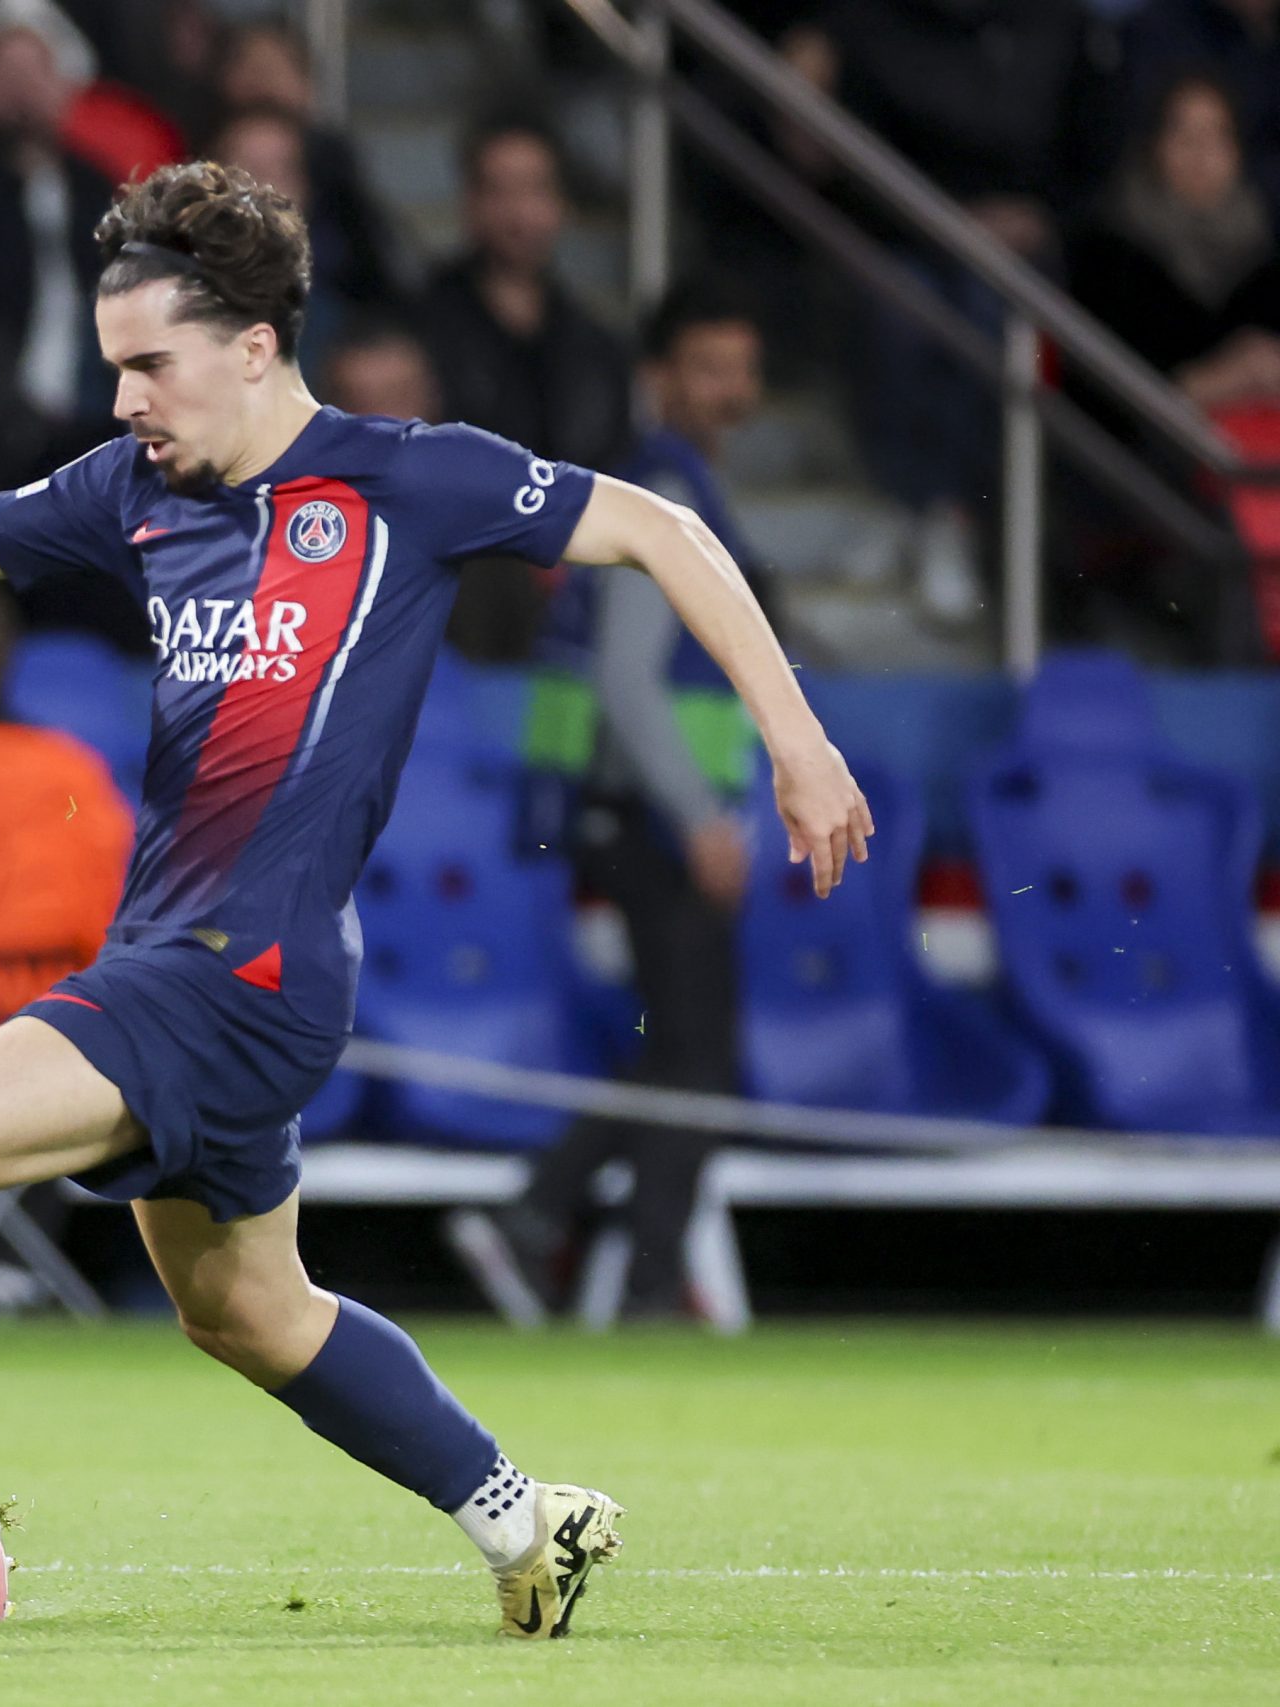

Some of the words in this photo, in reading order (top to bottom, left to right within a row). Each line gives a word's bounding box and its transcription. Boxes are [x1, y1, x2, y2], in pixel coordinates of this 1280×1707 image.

[513, 458, 557, 515] GO
[300, 503, 339, 521] PARIS
[147, 595, 308, 660] QATAR
[166, 650, 298, 684] AIRWAYS
